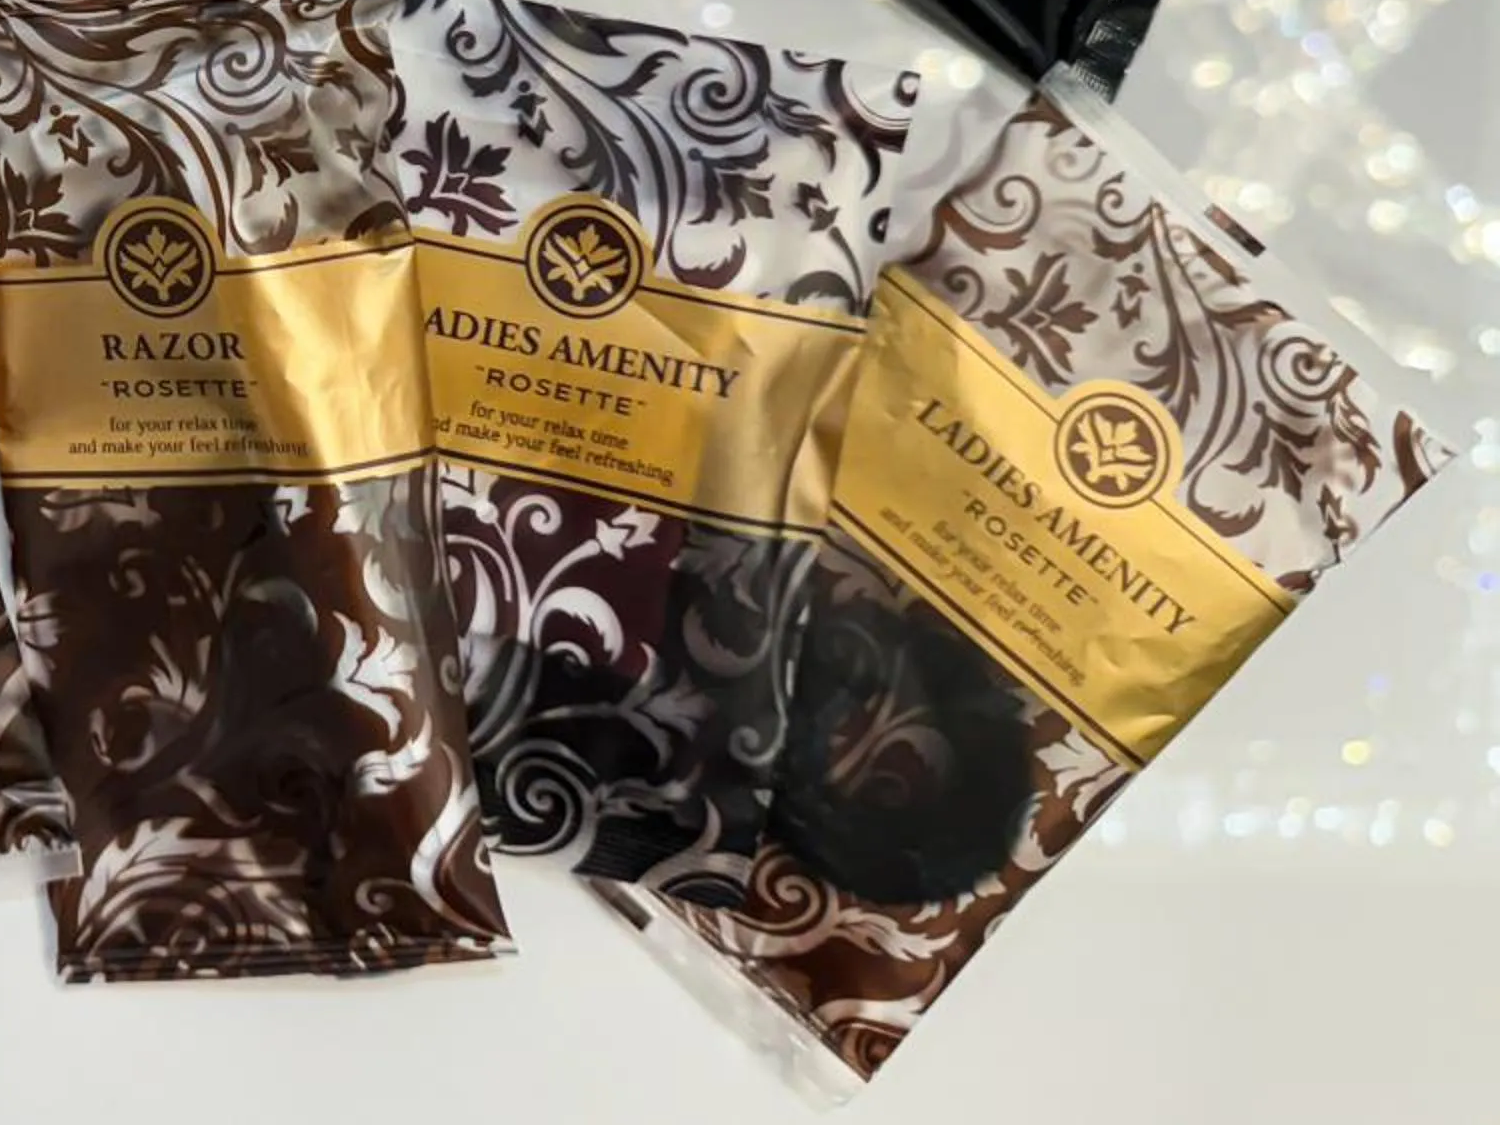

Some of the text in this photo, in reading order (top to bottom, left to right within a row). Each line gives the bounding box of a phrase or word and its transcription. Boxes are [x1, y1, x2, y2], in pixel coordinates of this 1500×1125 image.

[100, 331, 245, 362] RAZOR
[424, 306, 741, 399] ADIES AMENITY
[109, 415, 133, 432] for
[137, 418, 172, 436] your
[178, 414, 217, 432] relax
[470, 400, 630, 451] for your relax time
[69, 437, 97, 455] and
[101, 437, 144, 455] make
[148, 440, 184, 458] your
[190, 435, 219, 453] feel
[430, 415, 675, 488] nd make your feel refreshing
[915, 399, 1197, 636] LADIES AMENITY
[932, 519, 957, 543] for
[985, 592, 1016, 622] feel
